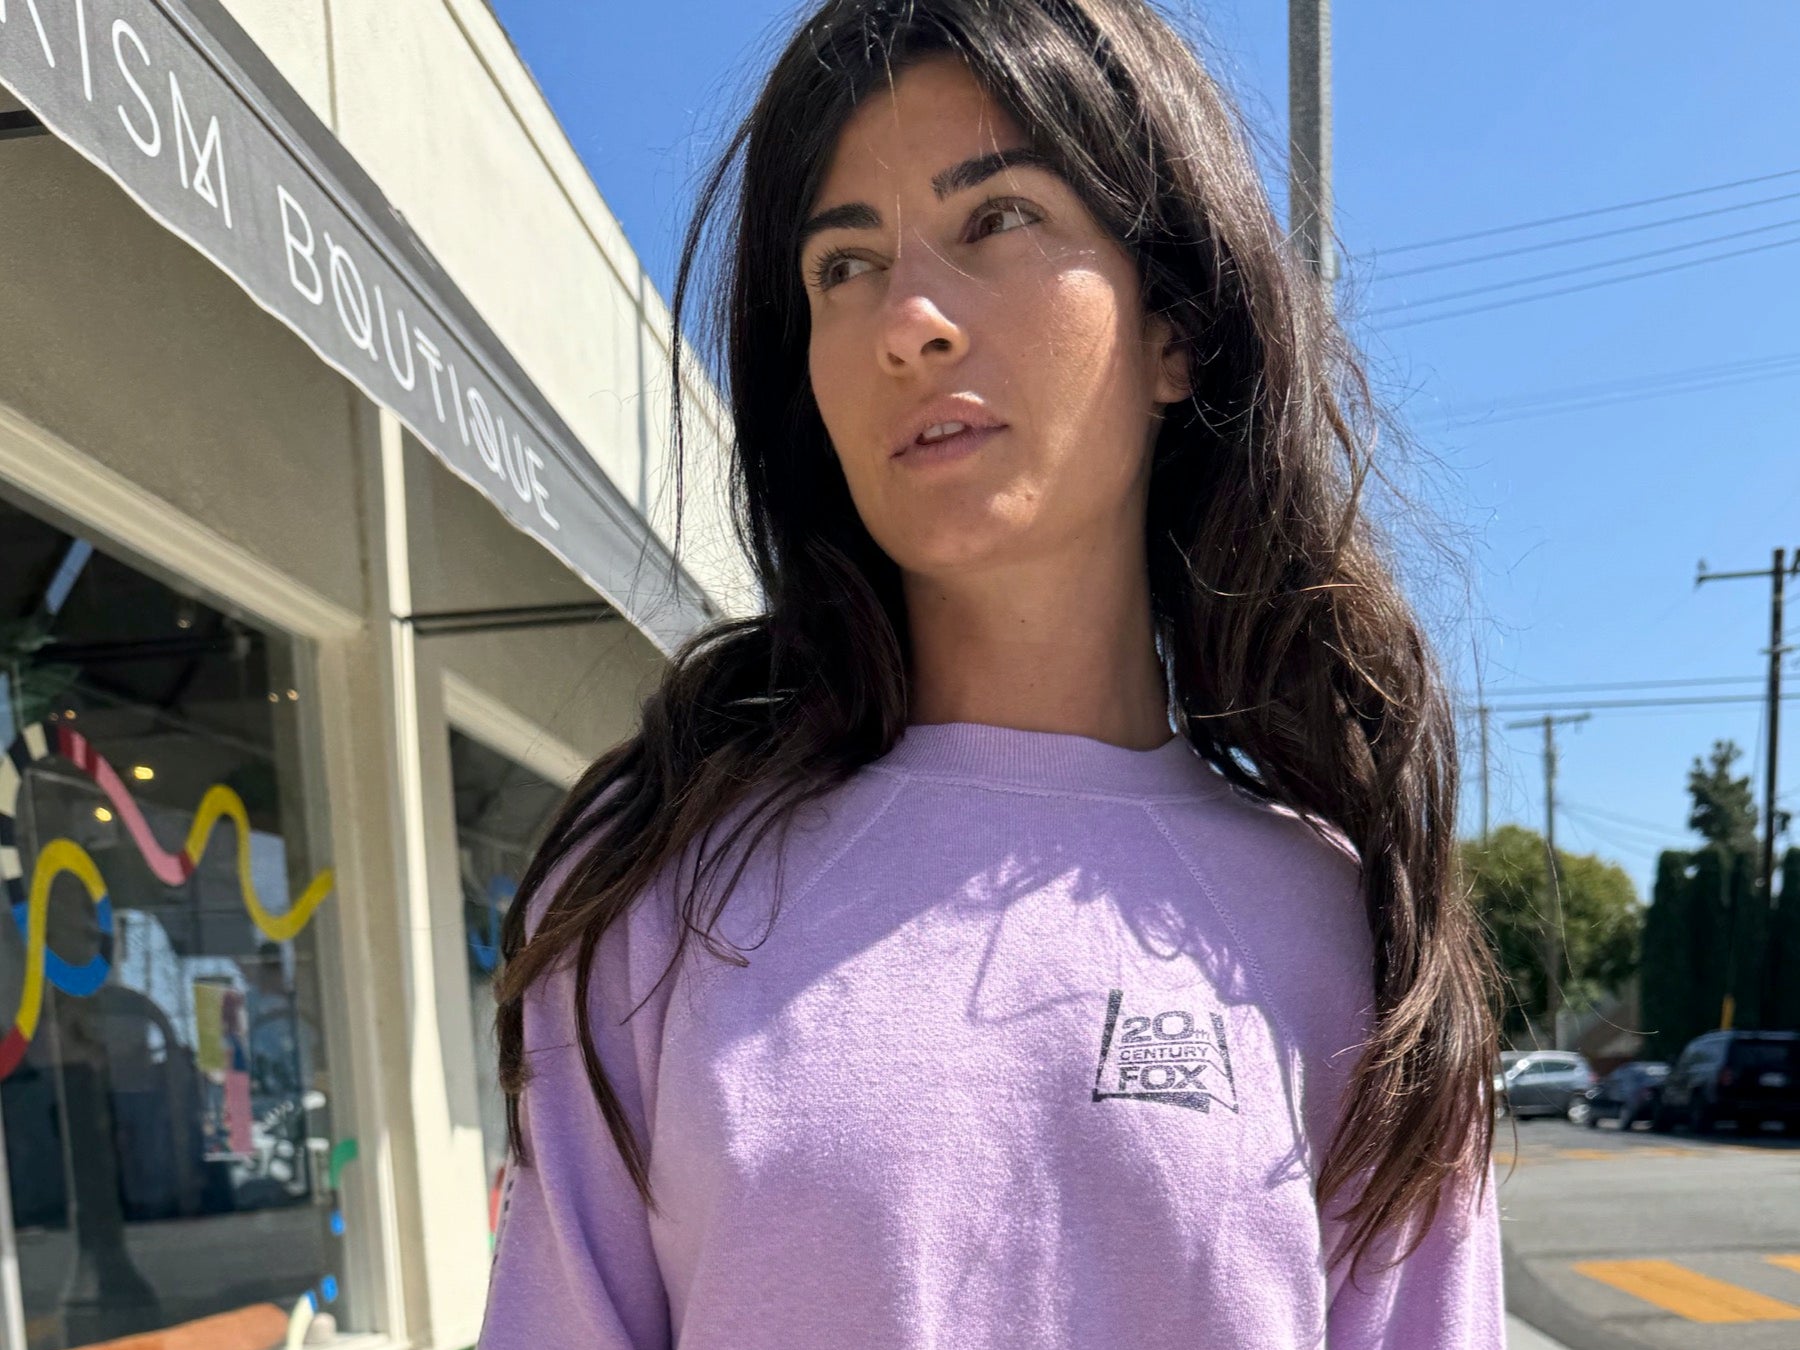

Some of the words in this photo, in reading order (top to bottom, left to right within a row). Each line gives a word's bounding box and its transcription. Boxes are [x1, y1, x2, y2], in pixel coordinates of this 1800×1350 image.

[277, 185, 560, 531] BOUTIQUE
[1120, 1046, 1208, 1061] CENTURY
[1118, 1064, 1208, 1092] FOX
